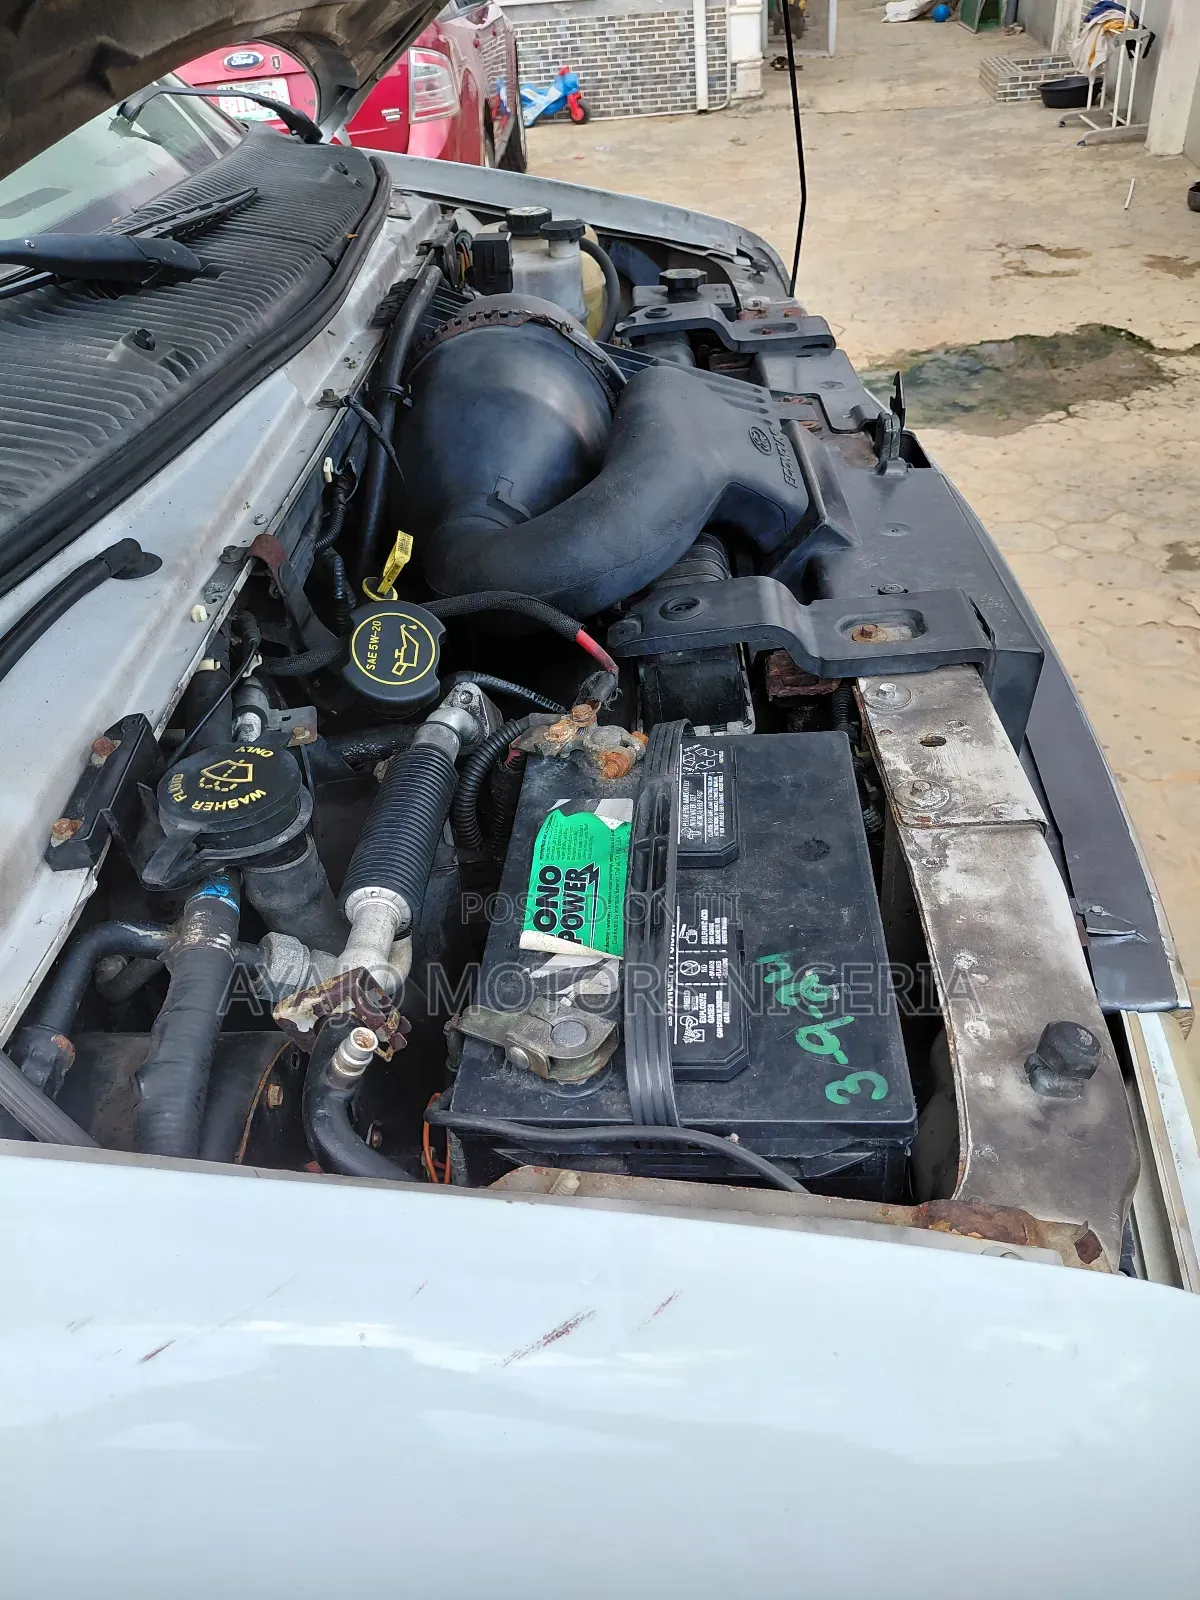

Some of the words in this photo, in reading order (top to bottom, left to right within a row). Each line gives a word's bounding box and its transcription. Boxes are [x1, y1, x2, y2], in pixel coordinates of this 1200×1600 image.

[231, 54, 255, 66] Ford
[368, 620, 382, 651] 5W-20
[365, 651, 378, 671] SAE
[235, 745, 274, 758] ONLY
[168, 773, 188, 803] FLUID
[191, 788, 267, 812] WASHER
[557, 866, 590, 944] POWER
[700, 964, 708, 973] NO
[707, 1003, 715, 1024] GASES
